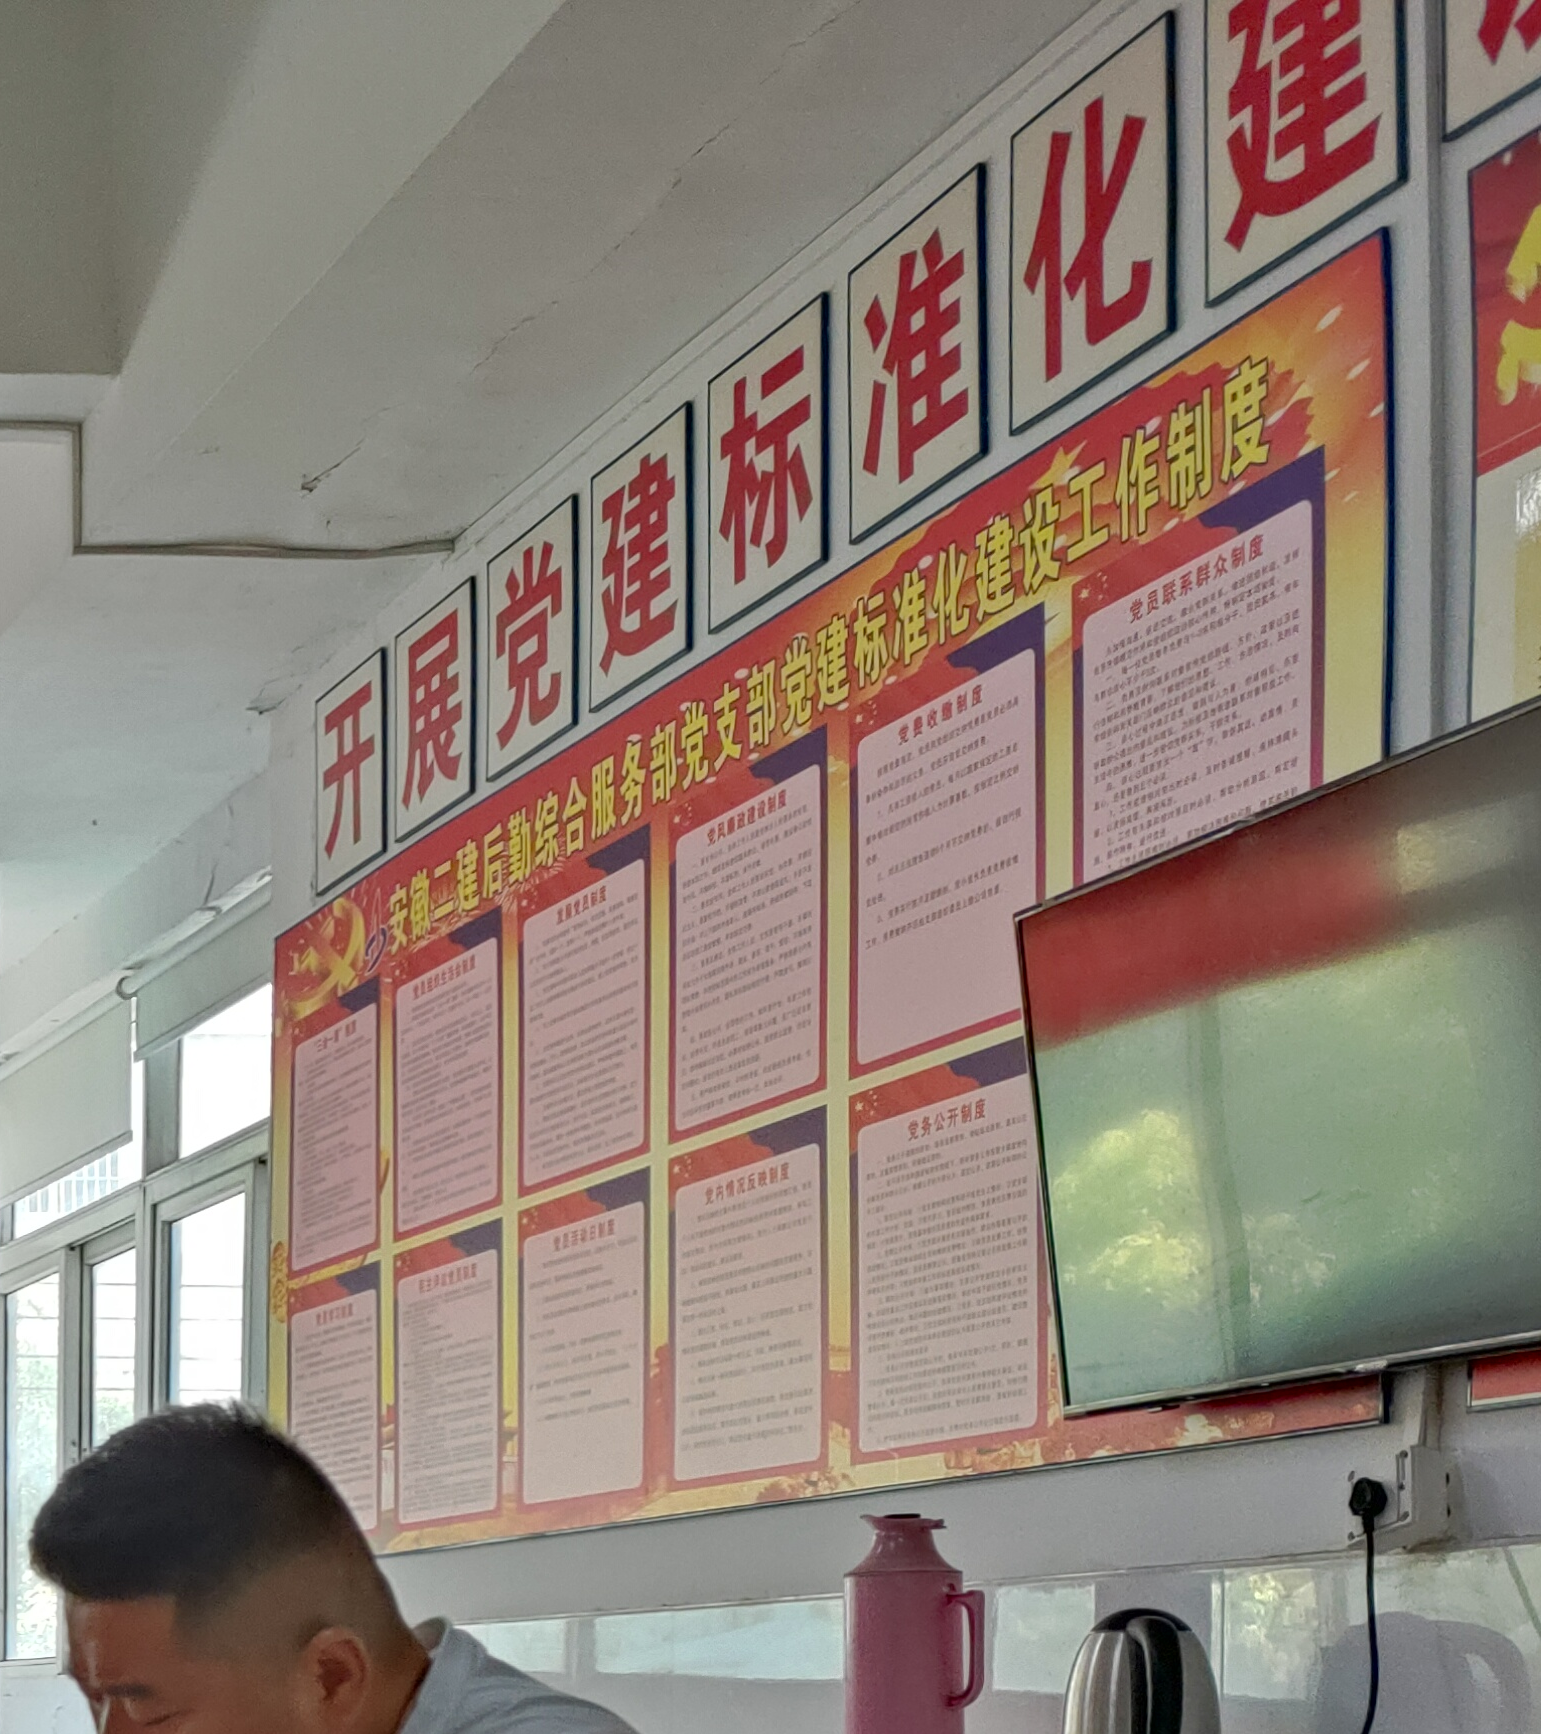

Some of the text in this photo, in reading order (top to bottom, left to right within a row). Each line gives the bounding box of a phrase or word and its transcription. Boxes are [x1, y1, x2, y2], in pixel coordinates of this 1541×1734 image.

[320, 0, 1541, 858] 开展党建标准化建
[1128, 533, 1265, 624] 党员联系群众制度
[388, 355, 1273, 956] 安徽二建后勤综合服务部党支部党建标准化建设工作制度
[907, 1098, 987, 1142] 党务公开制度
[704, 1161, 791, 1205] 党内情况反映制度
